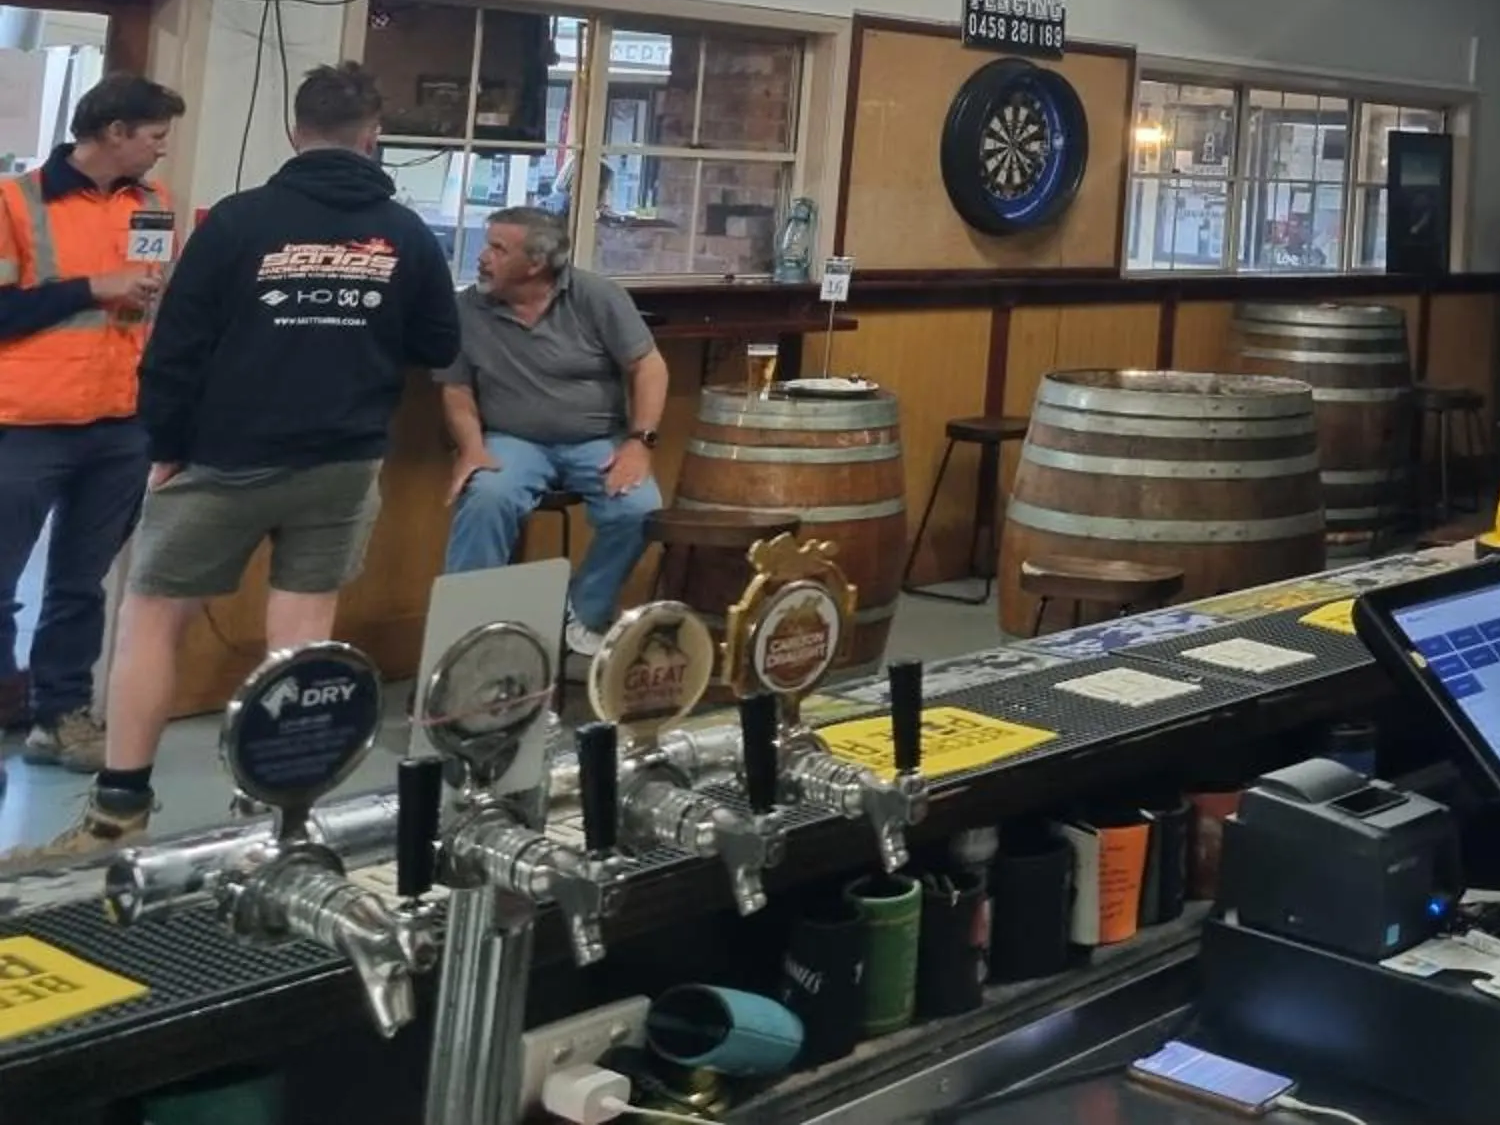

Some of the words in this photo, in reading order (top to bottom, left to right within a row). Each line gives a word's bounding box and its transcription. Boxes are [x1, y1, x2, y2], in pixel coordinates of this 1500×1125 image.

[136, 236, 164, 254] 24
[623, 664, 687, 691] GREAT
[302, 682, 357, 707] DRY
